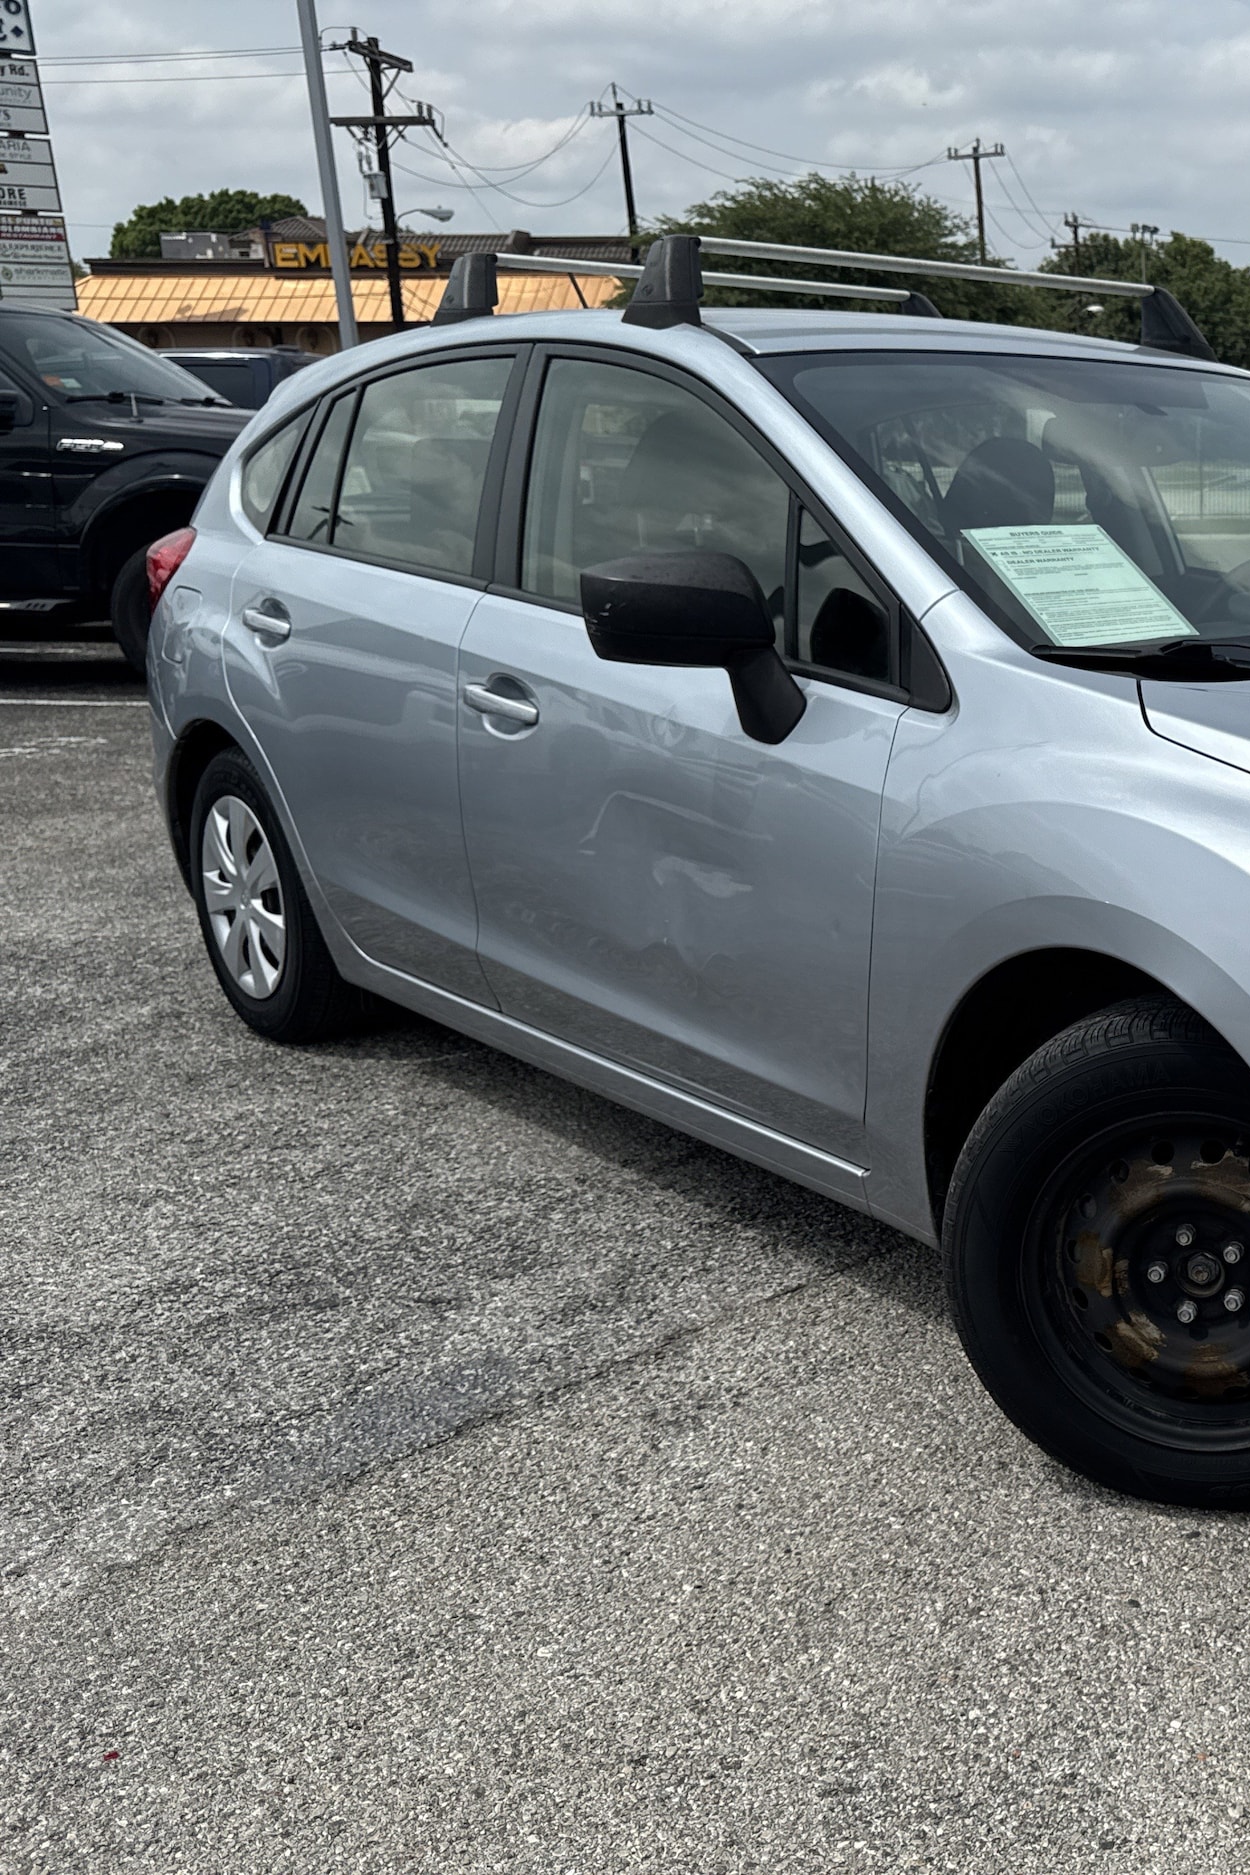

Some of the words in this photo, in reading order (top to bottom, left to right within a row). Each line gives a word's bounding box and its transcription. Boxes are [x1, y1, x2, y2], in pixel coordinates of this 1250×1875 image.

[9, 64, 30, 76] Rd.
[274, 242, 441, 268] EMASSY
[1023, 1061, 1171, 1130] YOKOHAMA
